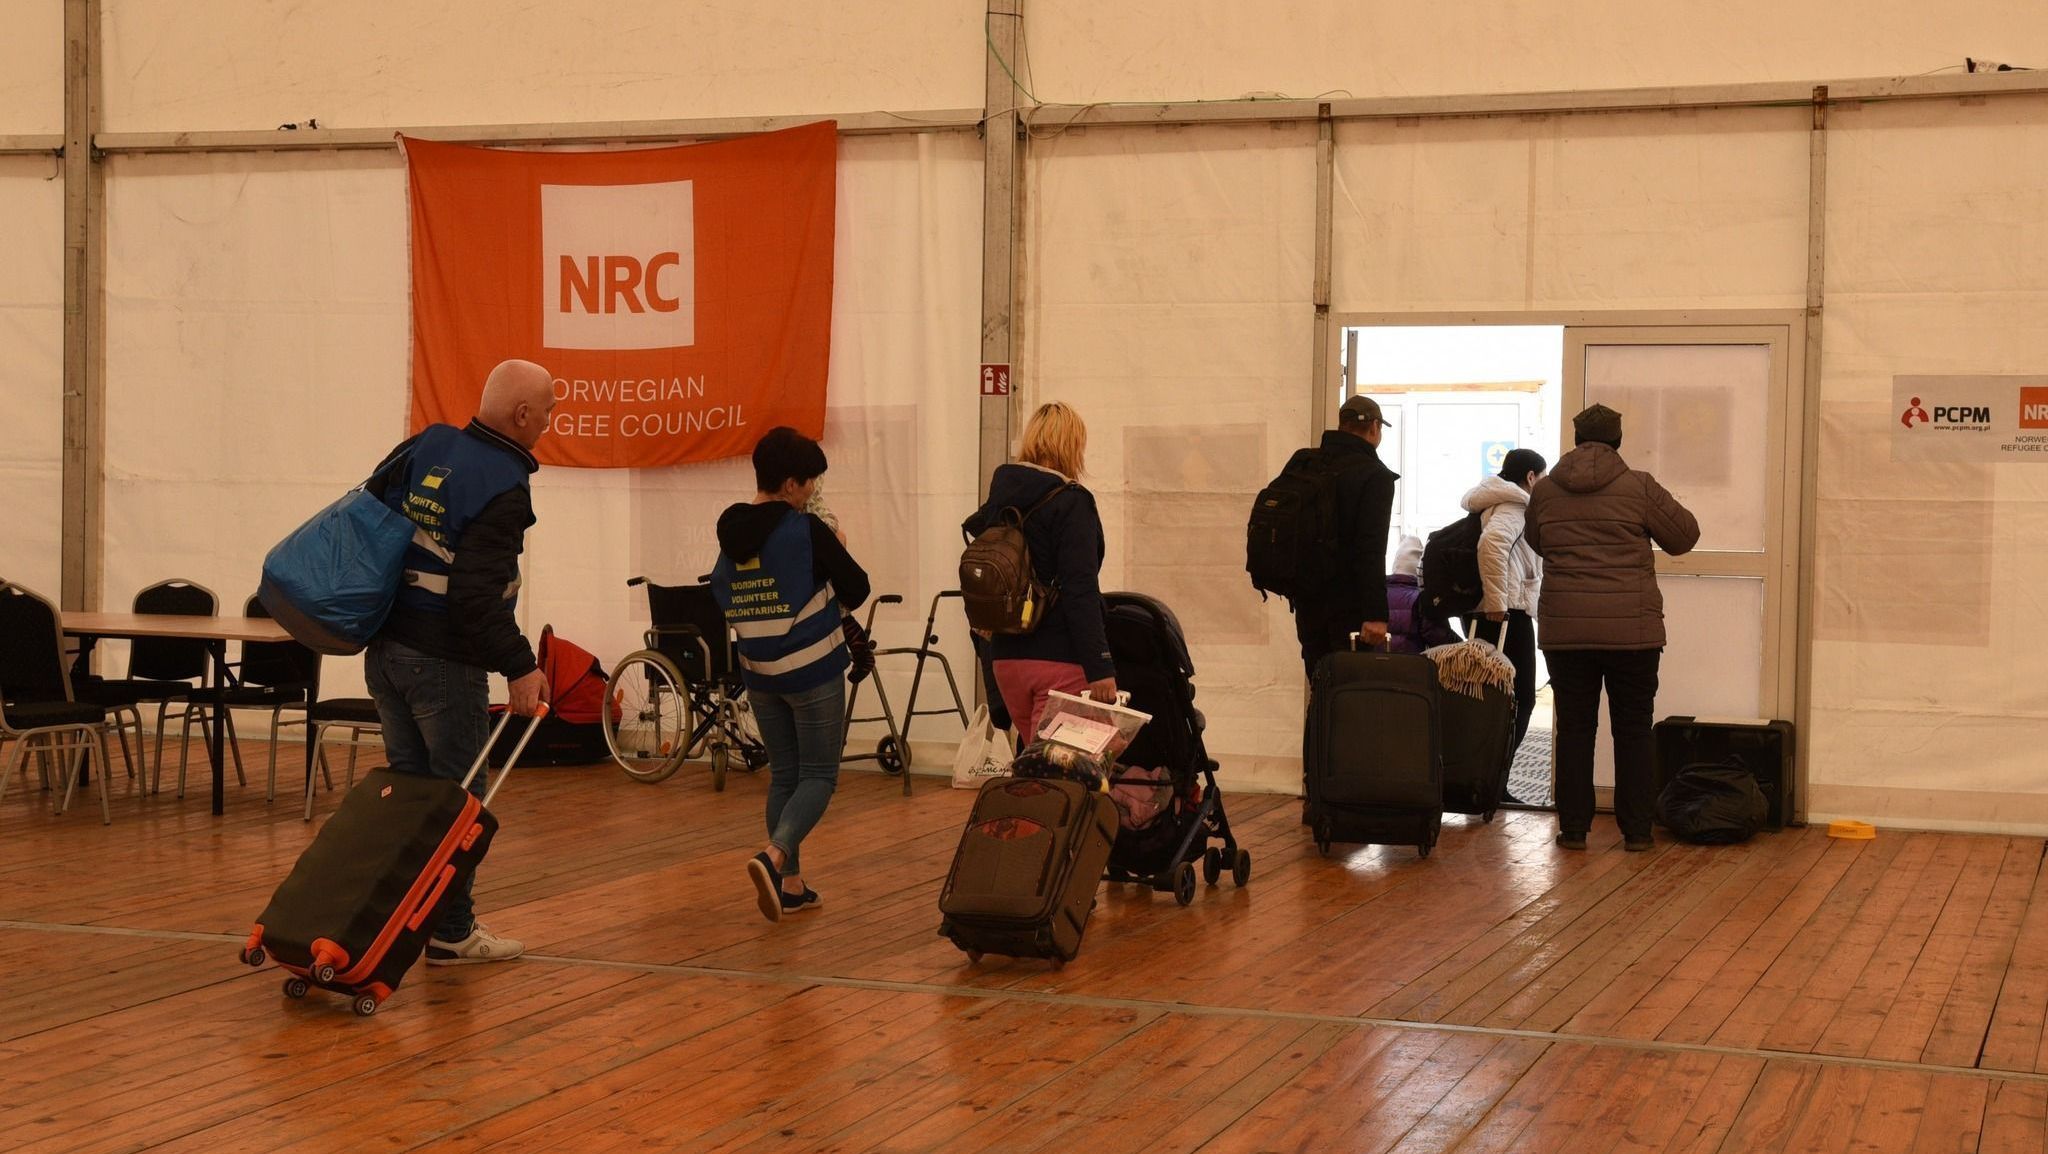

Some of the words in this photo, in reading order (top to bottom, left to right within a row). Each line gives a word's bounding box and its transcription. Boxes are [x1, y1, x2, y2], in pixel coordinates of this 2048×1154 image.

[560, 252, 680, 314] NRC
[552, 374, 704, 402] ORWEGIAN
[542, 412, 610, 437] UGEE
[619, 404, 747, 437] COUNCIL
[1934, 406, 1990, 422] PCPM
[2015, 435, 2048, 443] NORWE
[731, 591, 779, 604] VOLUNTEER
[724, 604, 790, 618] WOLONTARIUSZ
